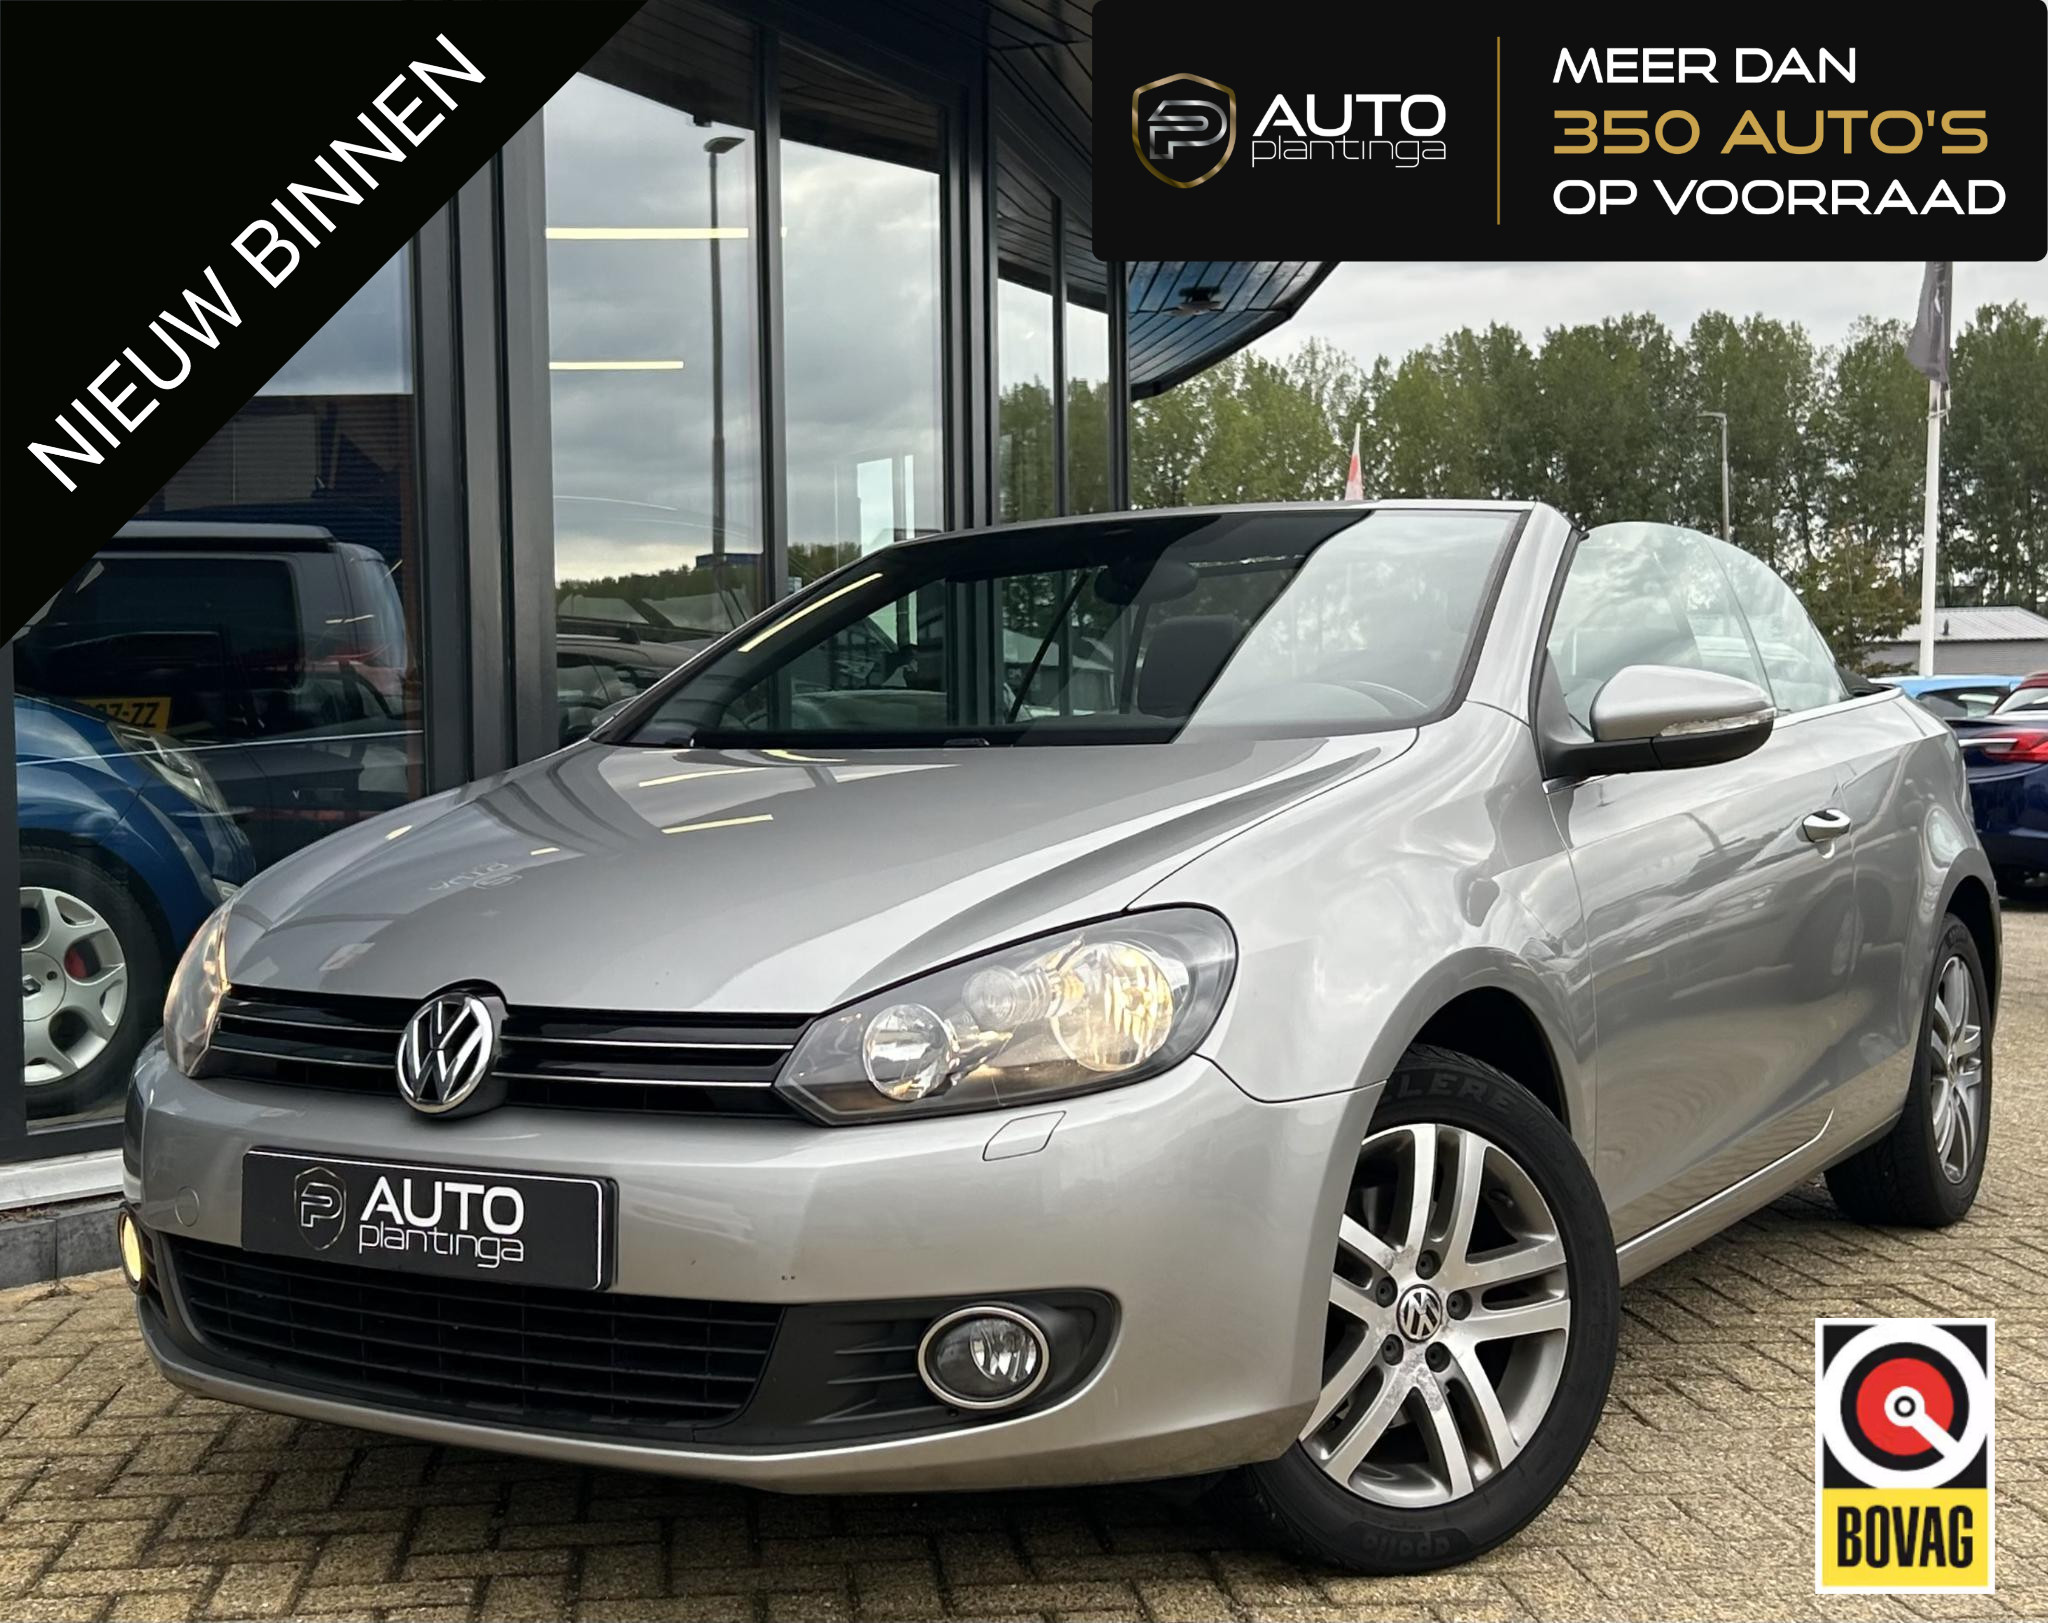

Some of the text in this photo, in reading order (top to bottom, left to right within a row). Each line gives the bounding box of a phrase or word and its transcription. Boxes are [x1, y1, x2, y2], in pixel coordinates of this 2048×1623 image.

[1380, 1072, 1518, 1114] LERE
[360, 1175, 524, 1235] AUTO
[358, 1220, 524, 1268] plantinga
